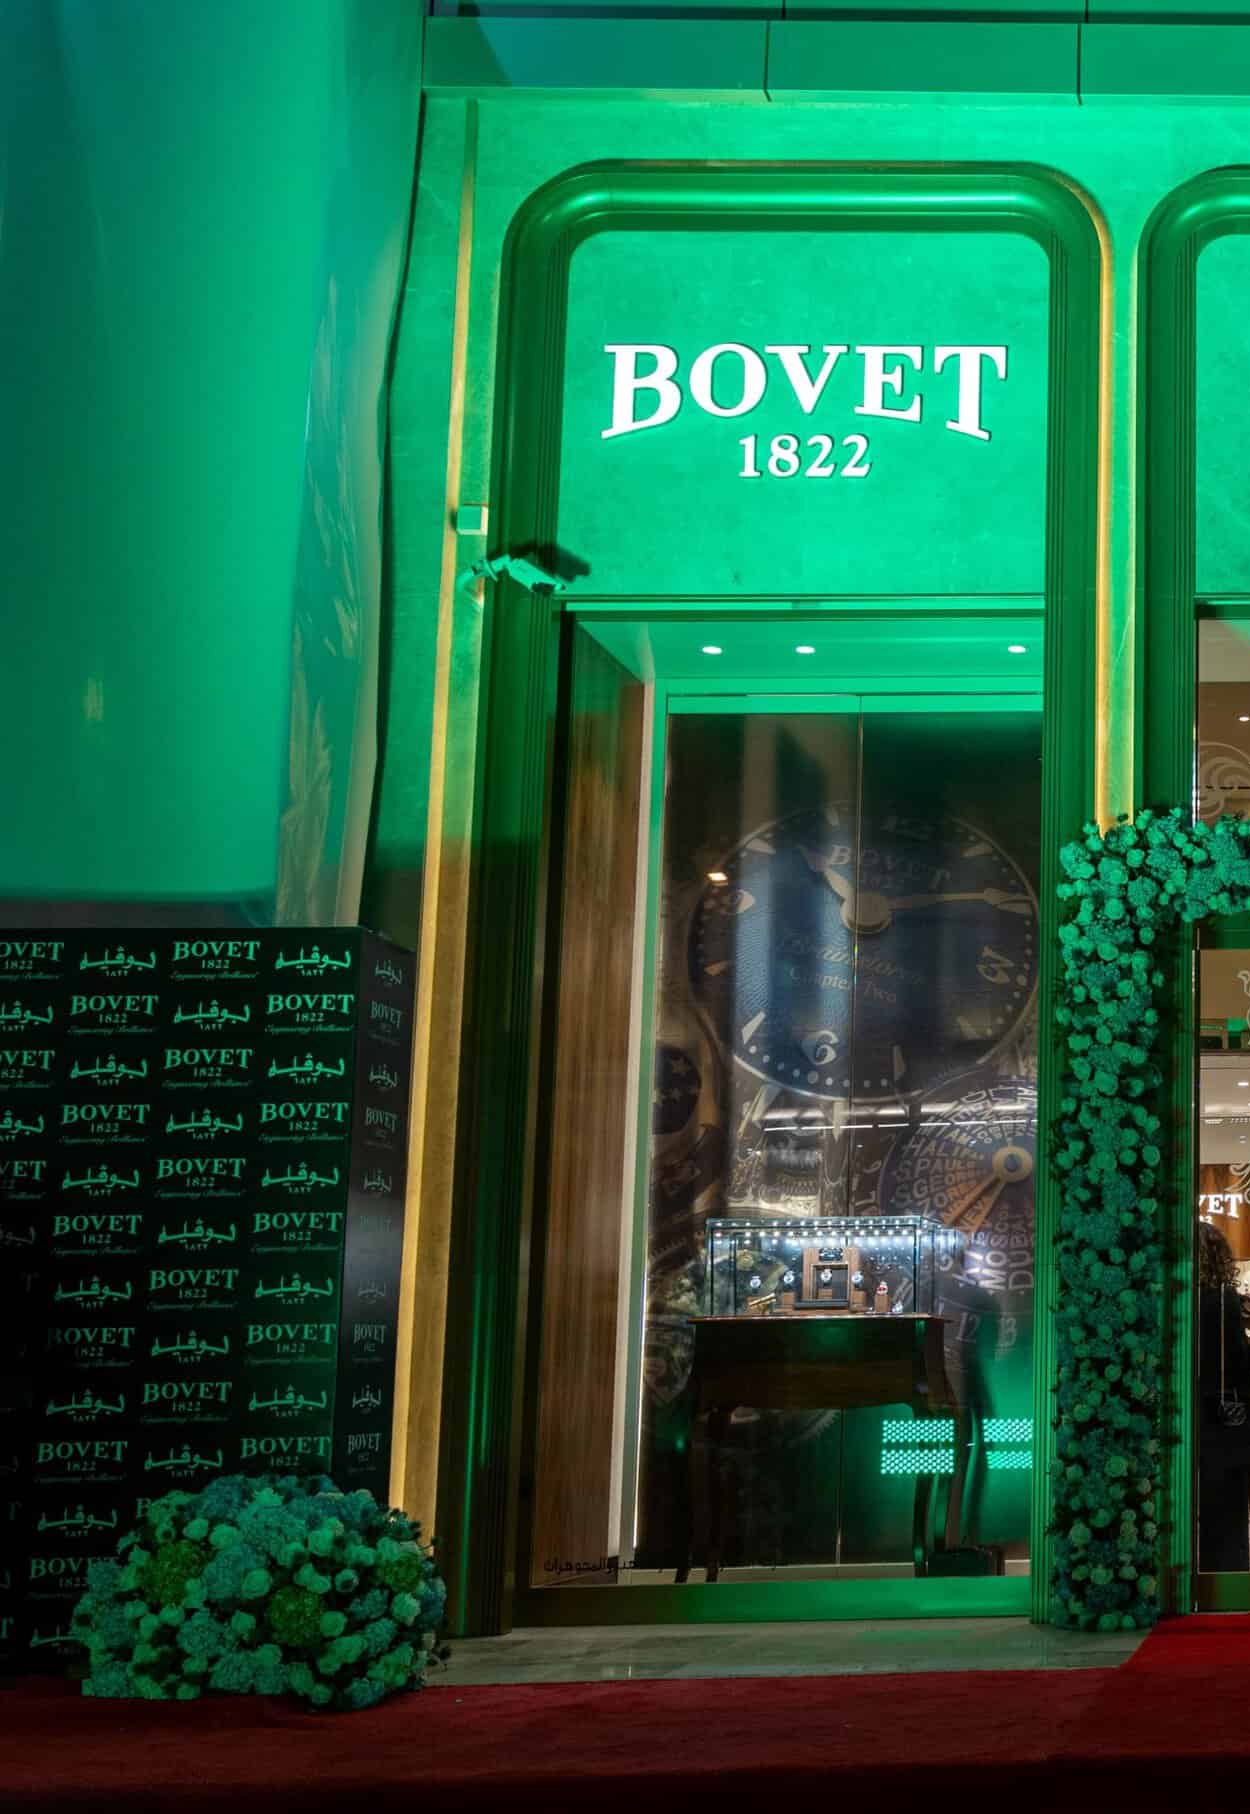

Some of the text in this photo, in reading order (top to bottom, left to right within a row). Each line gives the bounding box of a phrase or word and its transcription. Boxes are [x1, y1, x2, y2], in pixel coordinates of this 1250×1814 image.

[601, 343, 1007, 441] BOVET
[738, 433, 872, 478] 1822
[173, 941, 260, 961] BOVET
[4, 959, 33, 969] 1822
[200, 959, 230, 969] 1822
[70, 995, 158, 1015] BOVET
[266, 995, 354, 1013] BOVET
[98, 1013, 127, 1023] 1822
[296, 1013, 324, 1022] 1822
[164, 1049, 253, 1069] BOVET
[193, 1067, 222, 1077] 1822
[63, 1105, 150, 1124] BOVET
[260, 1103, 348, 1122] BOVET
[90, 1122, 119, 1133] 1822
[289, 1121, 317, 1130] 1822
[156, 1159, 246, 1178] BOVET
[186, 1177, 214, 1186] 1822
[53, 1216, 142, 1236] BOVET
[254, 1212, 343, 1232] BOVET
[82, 1233, 111, 1244] 1822
[283, 1231, 311, 1241] 1822
[150, 1270, 238, 1290] BOVET
[178, 1288, 207, 1298] 1822
[248, 1324, 336, 1344] BOVET
[276, 1343, 305, 1353] 1822
[143, 1382, 232, 1404] BOVET
[172, 1401, 200, 1412] 1822
[37, 1441, 128, 1463] BOVET
[241, 1436, 331, 1458] BOVET
[66, 1460, 96, 1472] 1822
